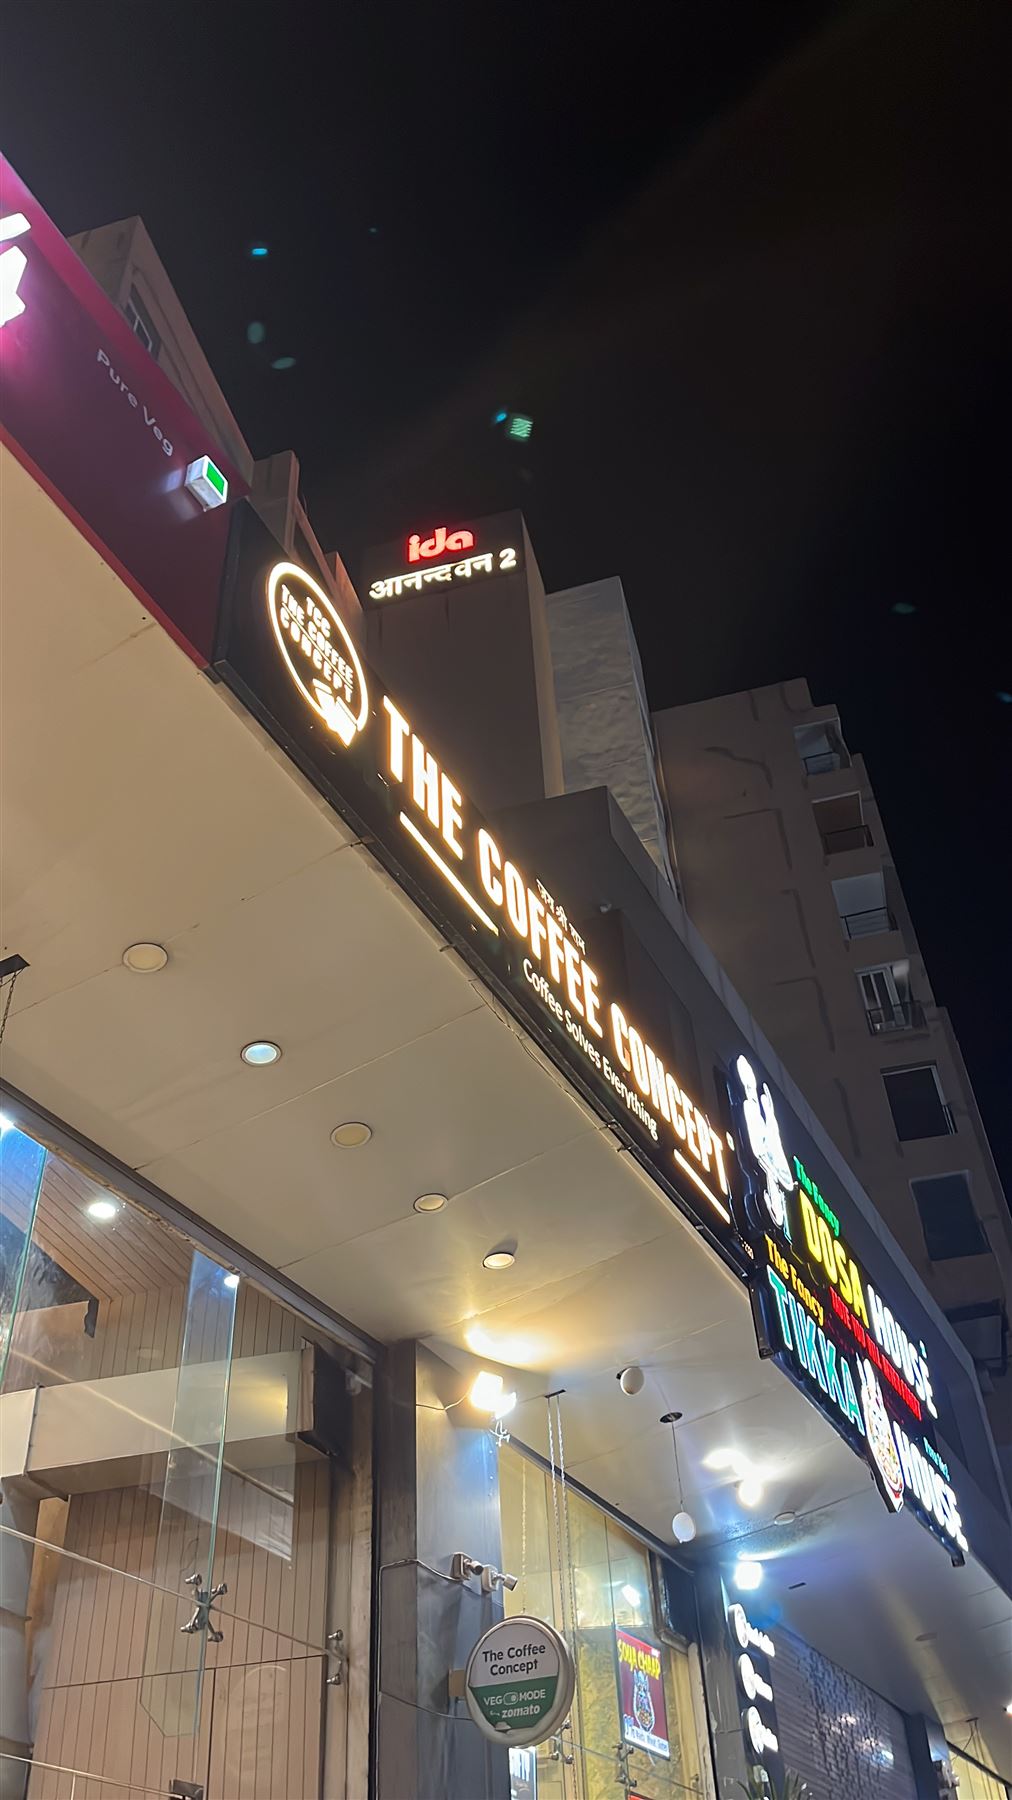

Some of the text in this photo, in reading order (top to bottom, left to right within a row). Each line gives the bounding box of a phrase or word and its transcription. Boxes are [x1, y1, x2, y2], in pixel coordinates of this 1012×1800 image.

[97, 348, 174, 457] Pure Veg
[408, 527, 475, 563] ida
[498, 547, 517, 570] 2
[280, 606, 353, 703] CONCEPT
[281, 584, 354, 685] THE COFFEE
[306, 596, 331, 638] TCC
[383, 694, 729, 1196] THE COFFEE CONCEPT
[522, 958, 659, 1141] Coffee Solves Everything
[764, 1233, 825, 1328] The Fancy
[798, 1187, 938, 1420] DOSA HOUSE
[766, 1264, 867, 1438] TIKKA
[893, 1420, 970, 1553] HOUSE
[482, 1643, 546, 1663] The Coffee
[483, 1689, 546, 1706] VEG MODE
[490, 1659, 539, 1677] Concept
[501, 1704, 541, 1719] zomato
